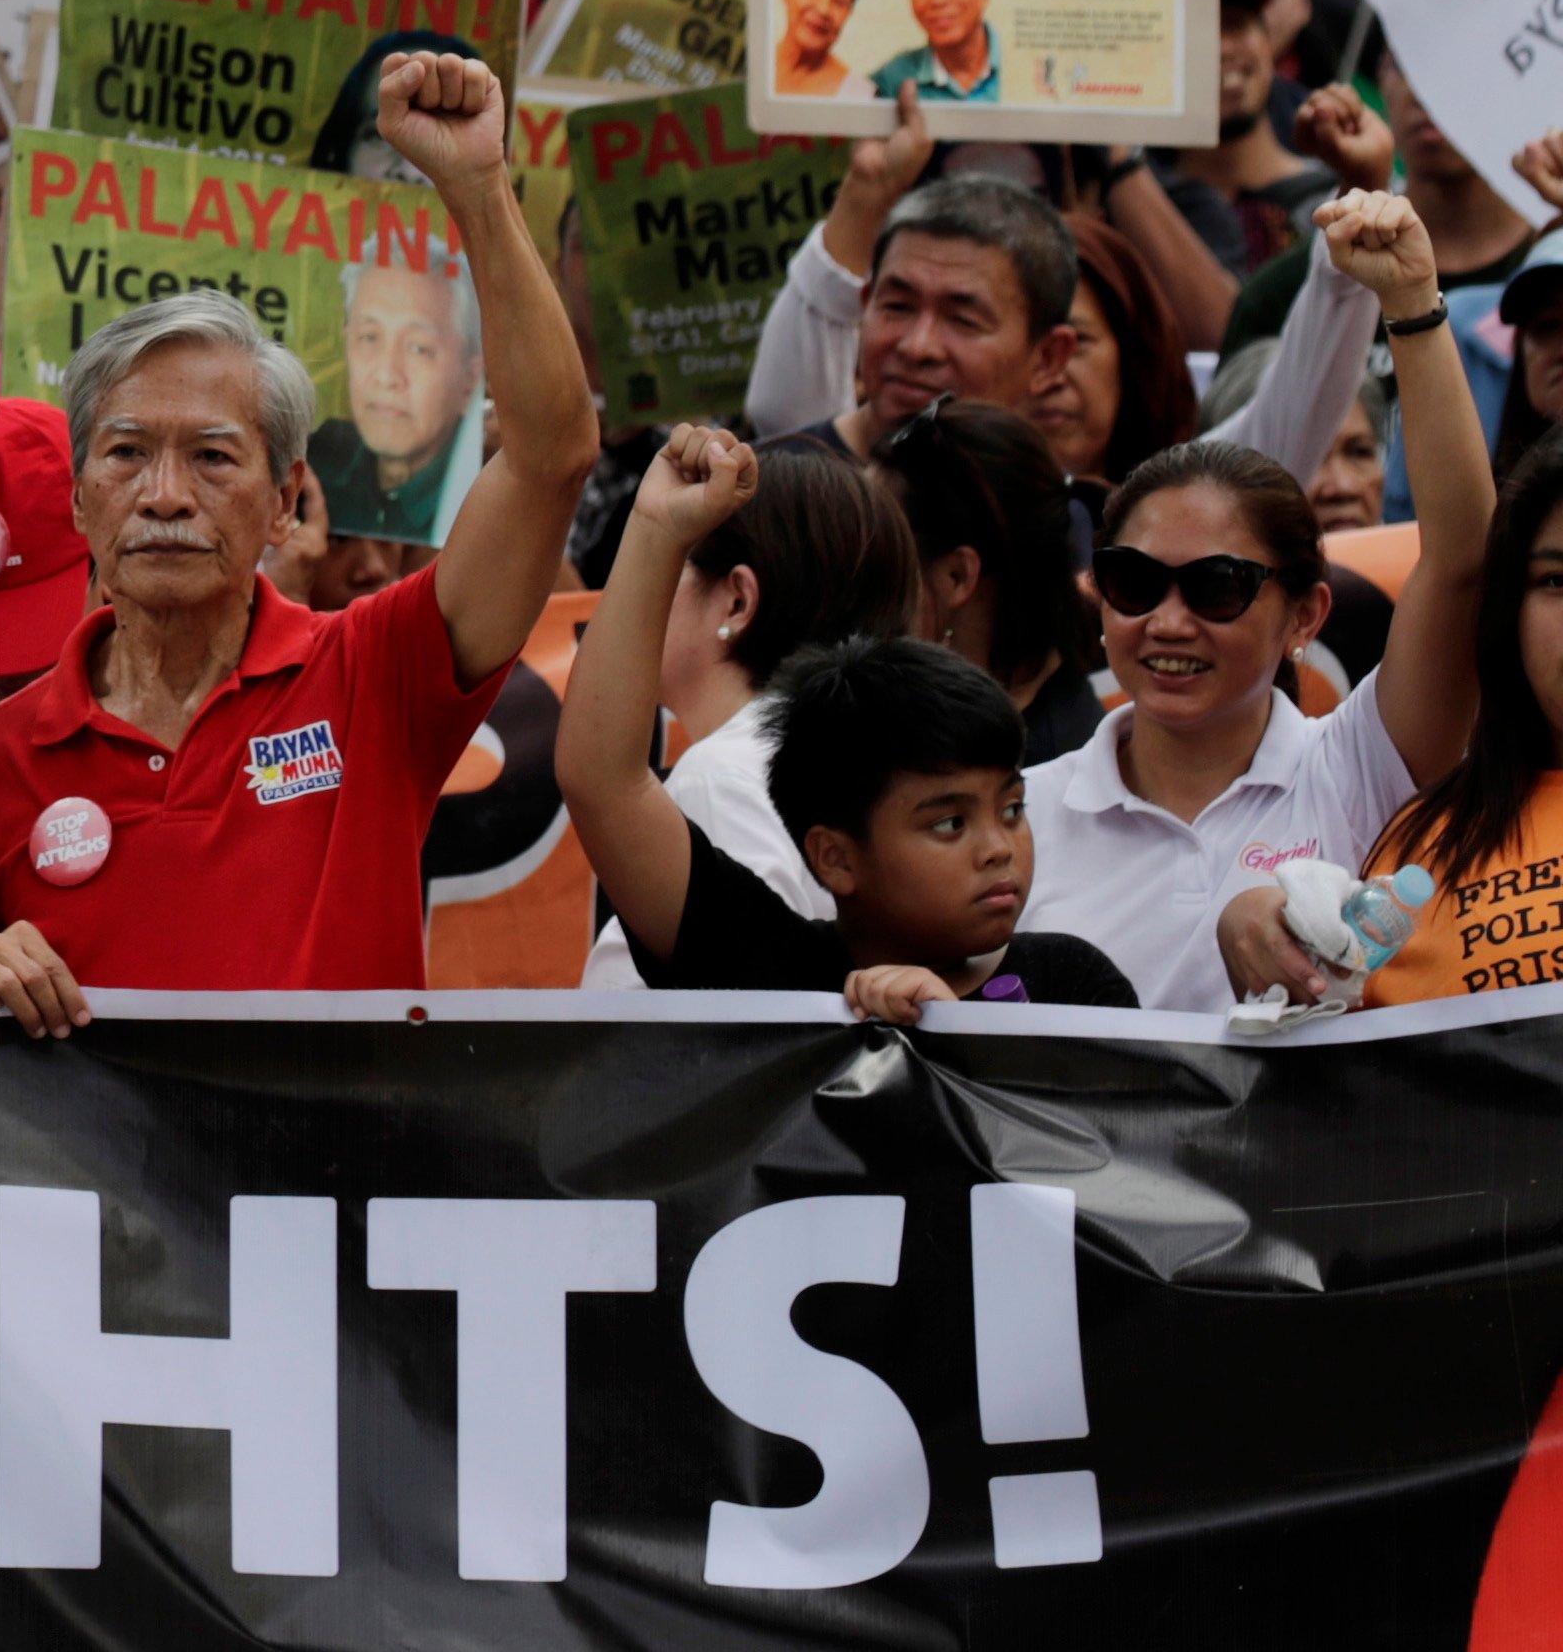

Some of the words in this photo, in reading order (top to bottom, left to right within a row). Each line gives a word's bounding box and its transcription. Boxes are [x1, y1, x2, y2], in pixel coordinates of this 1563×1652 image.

[110, 15, 296, 94] Wilson
[94, 66, 293, 146] Cultivo
[590, 104, 845, 183] PAL
[29, 150, 462, 278] PALAYAIN!
[51, 243, 290, 325] Vicente
[254, 724, 331, 768] BAYAN
[281, 750, 343, 784] MUNA
[262, 773, 343, 801] PARTY-LIST
[46, 811, 90, 838] STOP
[57, 828, 83, 846] THE
[35, 834, 109, 870] ATTACKS
